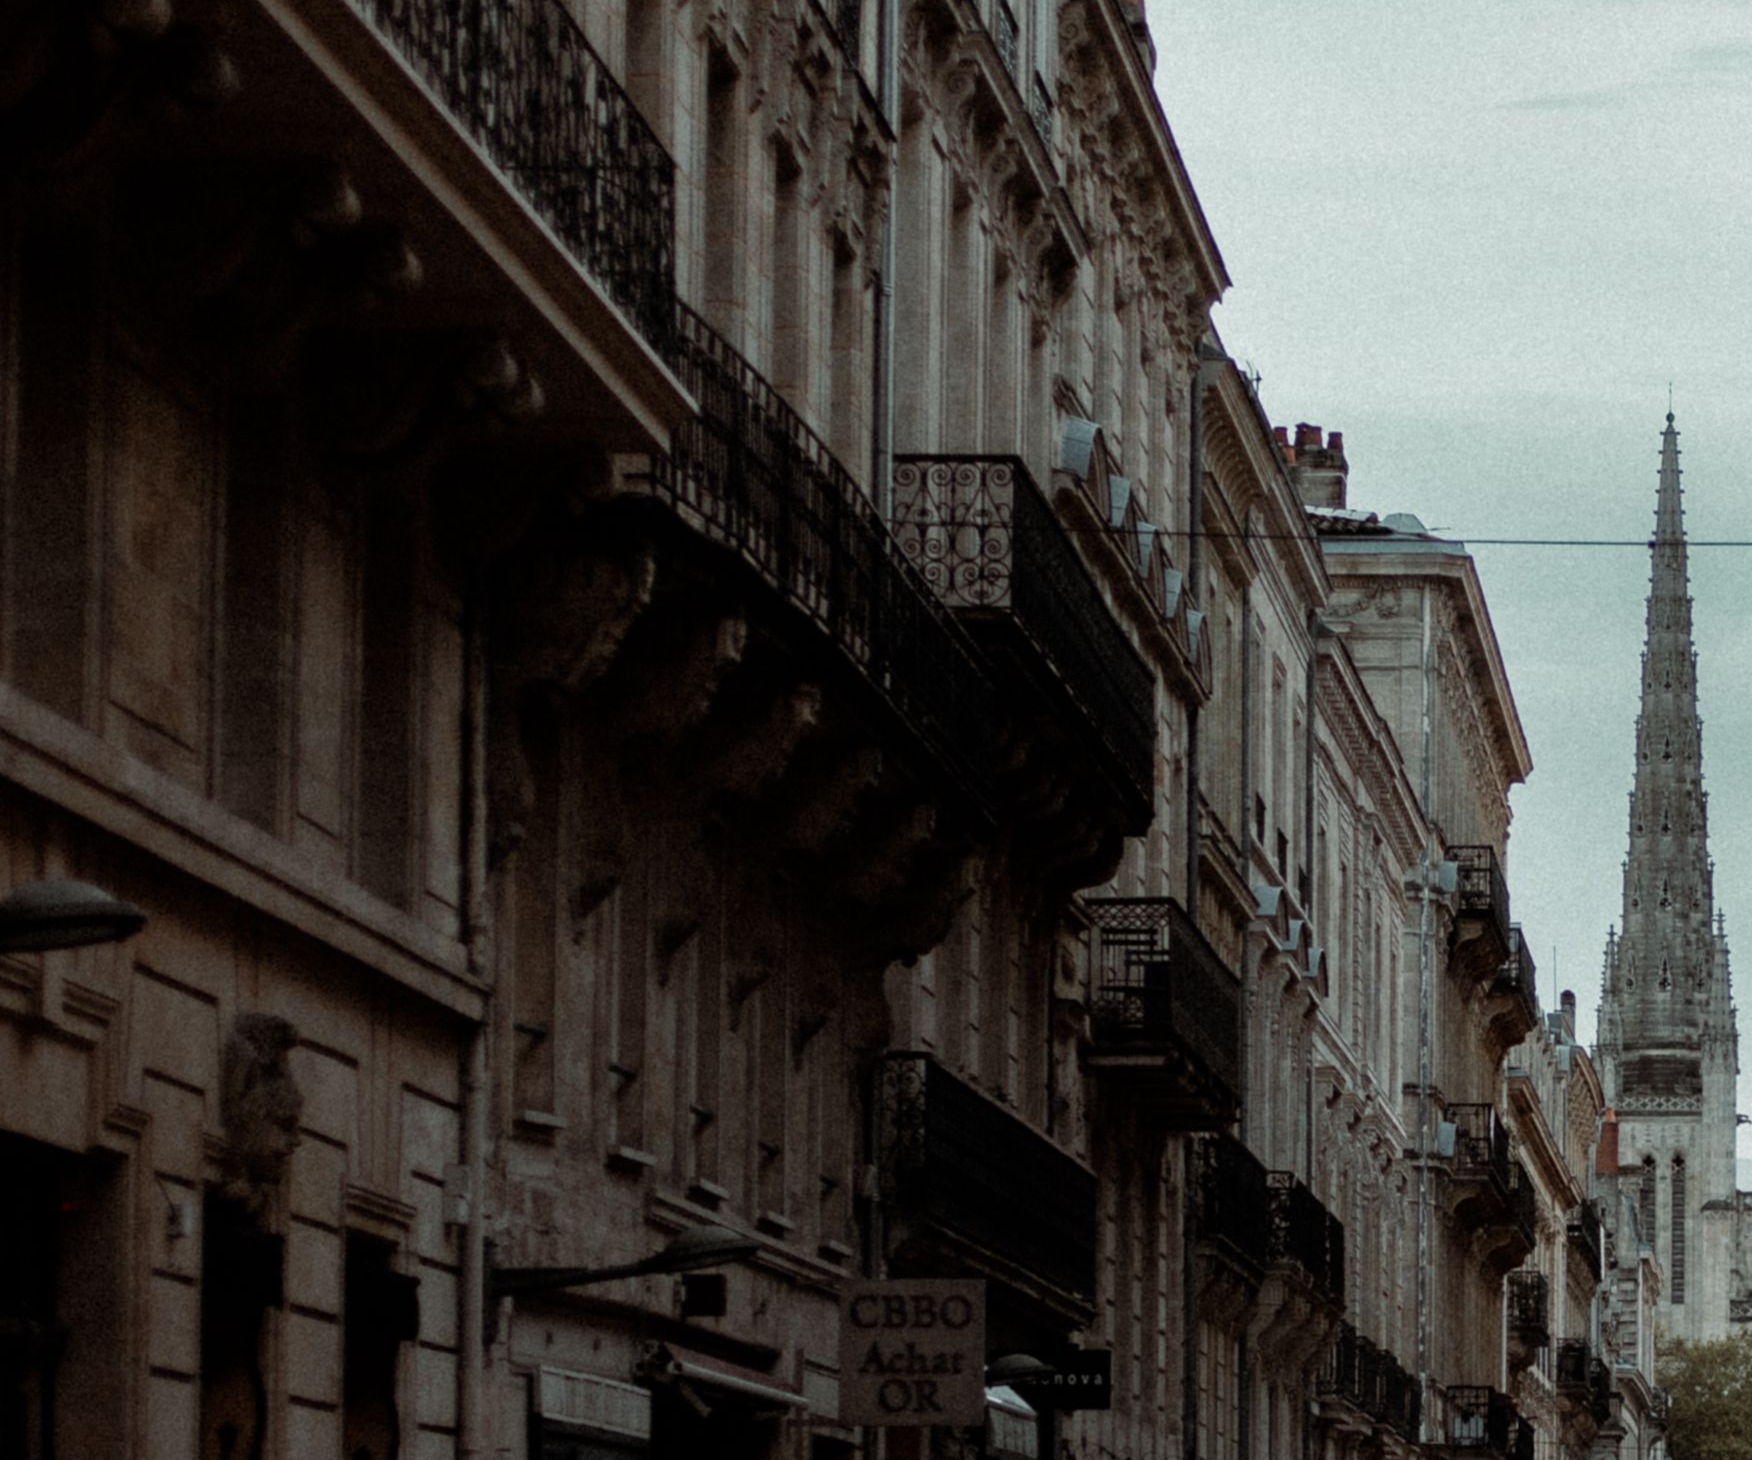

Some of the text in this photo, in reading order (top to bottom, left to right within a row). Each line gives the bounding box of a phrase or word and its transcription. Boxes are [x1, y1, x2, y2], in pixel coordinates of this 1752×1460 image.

[849, 1294, 971, 1329] CBBO
[858, 1341, 965, 1373] Achat
[878, 1378, 942, 1413] OR
